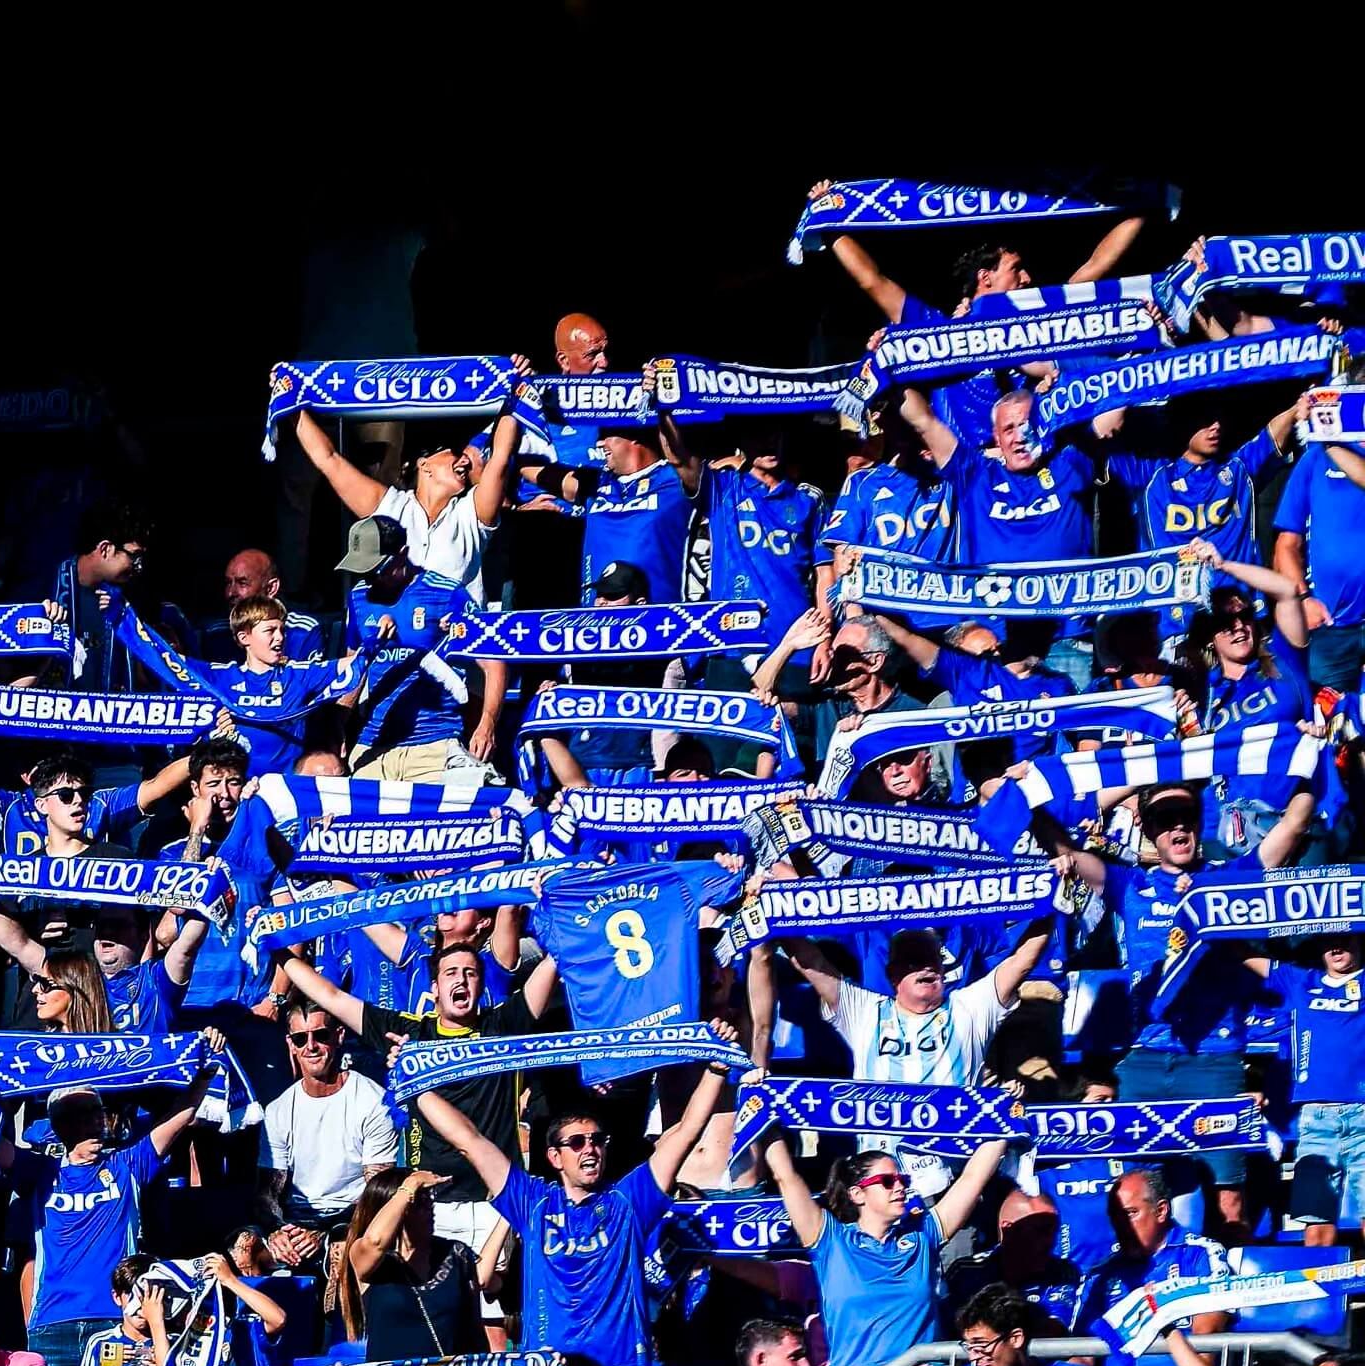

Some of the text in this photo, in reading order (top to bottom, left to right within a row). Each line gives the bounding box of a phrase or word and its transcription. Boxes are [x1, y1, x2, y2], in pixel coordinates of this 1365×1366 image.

[917, 189, 1027, 217] CICLO
[353, 376, 457, 400] CICLO
[867, 561, 1172, 605] REAL OVIEDO
[538, 625, 647, 652] CICLO
[535, 690, 747, 725] Real OVIEDO
[49, 856, 138, 891] OVIEDO
[152, 865, 210, 898] 1926
[590, 883, 659, 916] CAZORLA
[1206, 892, 1280, 925] Real
[830, 1099, 938, 1130] CICLO
